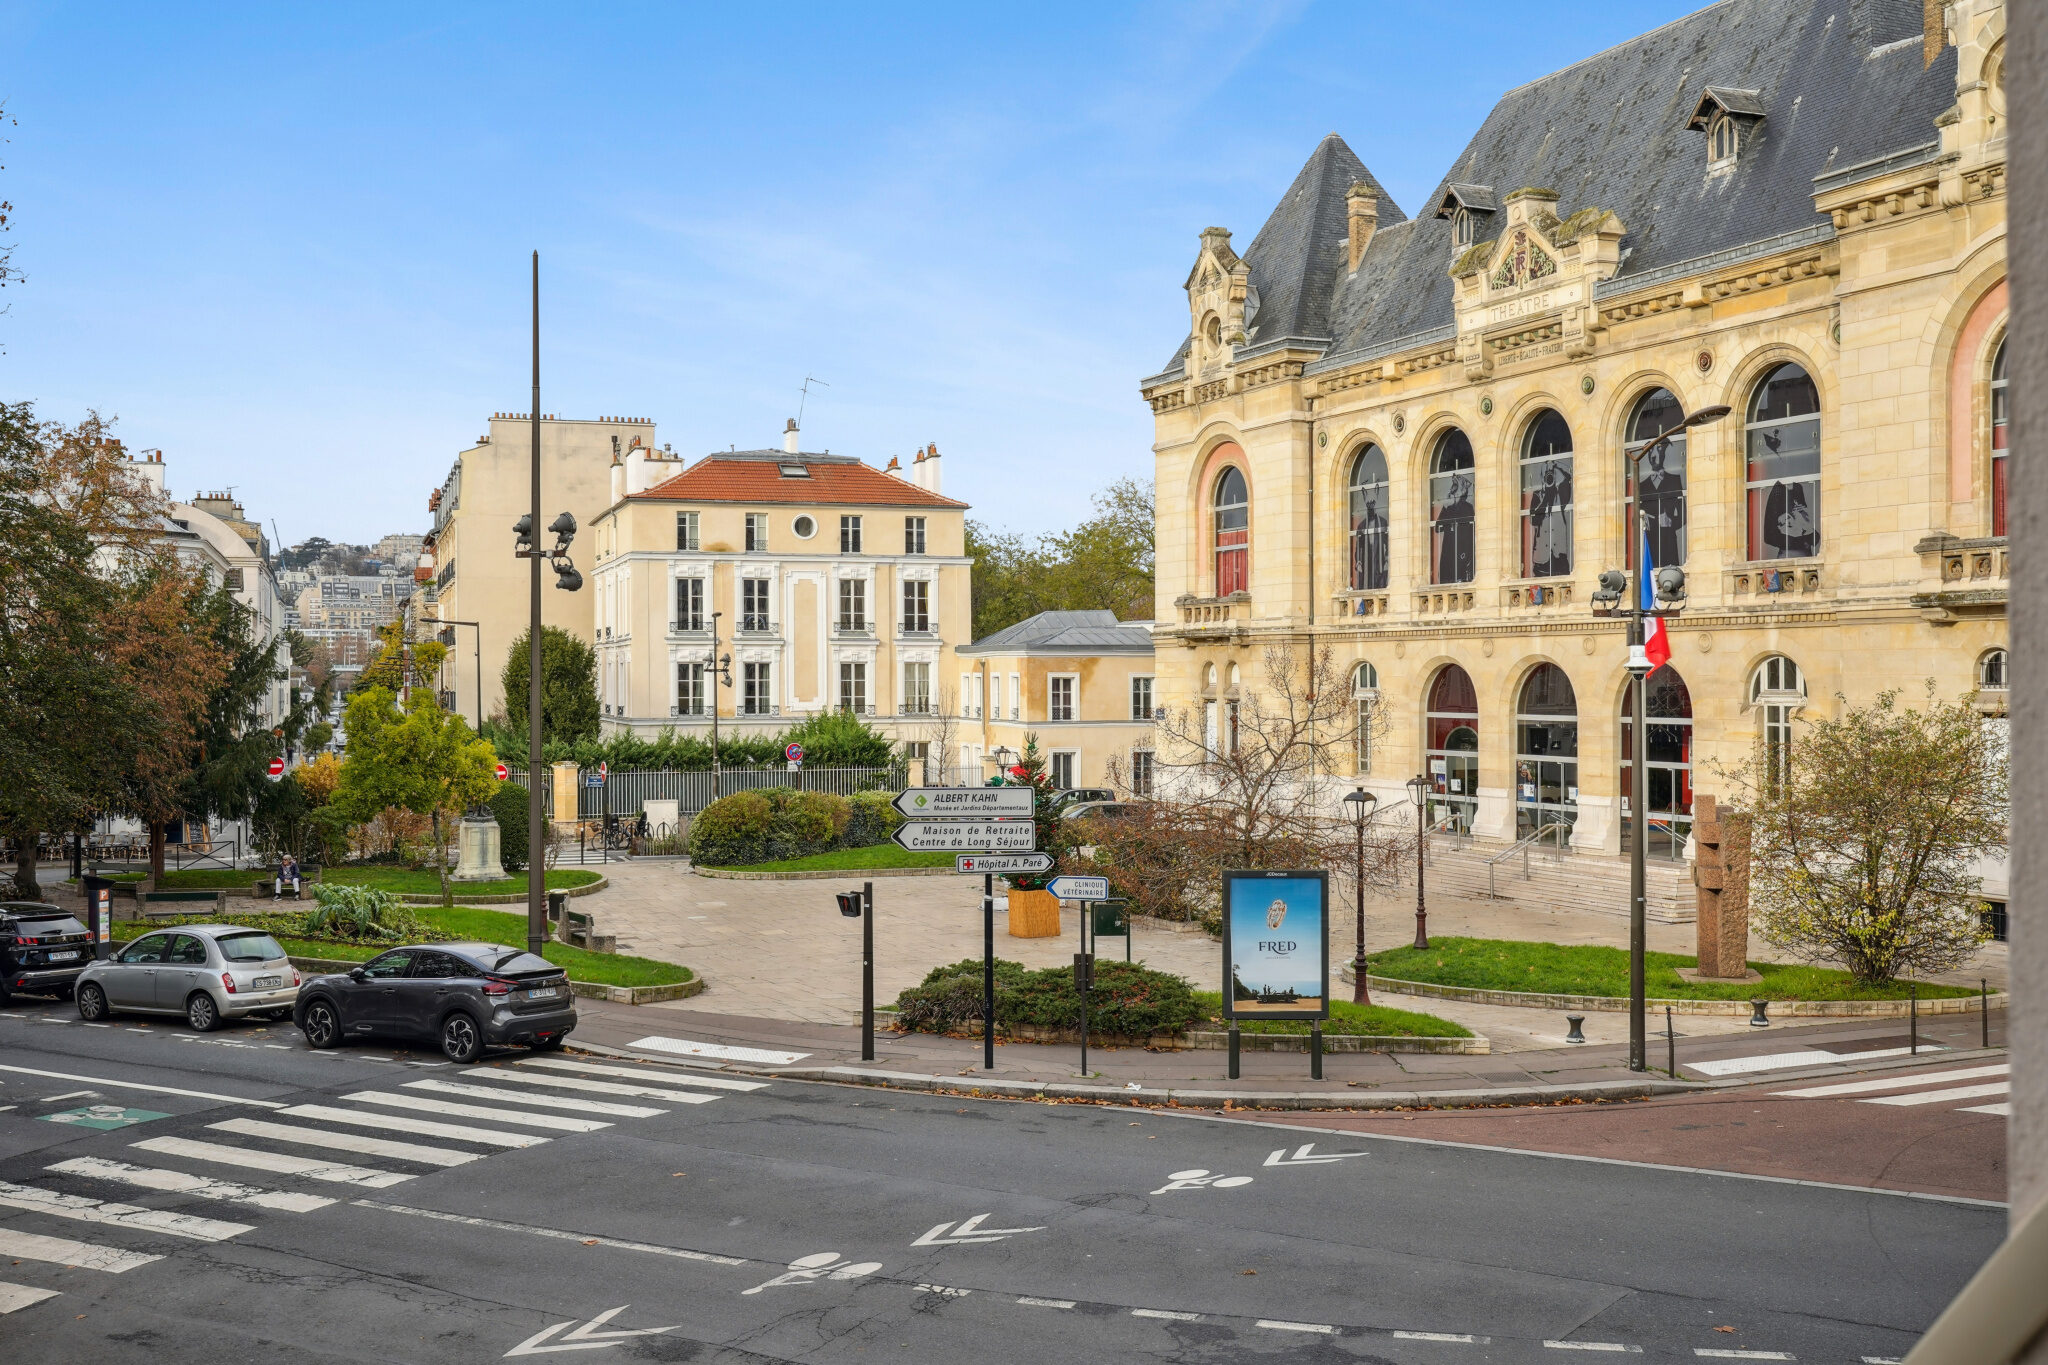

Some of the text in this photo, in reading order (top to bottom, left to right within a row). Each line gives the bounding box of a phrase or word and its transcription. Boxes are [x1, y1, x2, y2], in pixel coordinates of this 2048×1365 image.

[934, 794, 998, 802] ALBERT KAHN
[923, 826, 1030, 835] Maison de Retraite
[912, 837, 1030, 848] Centre de Long Séjour
[977, 858, 1043, 870] Hôpital A. Paré
[101, 890, 108, 899] P
[1063, 888, 1104, 896] VÉTÉRINAIRE
[1258, 941, 1297, 955] FRED
